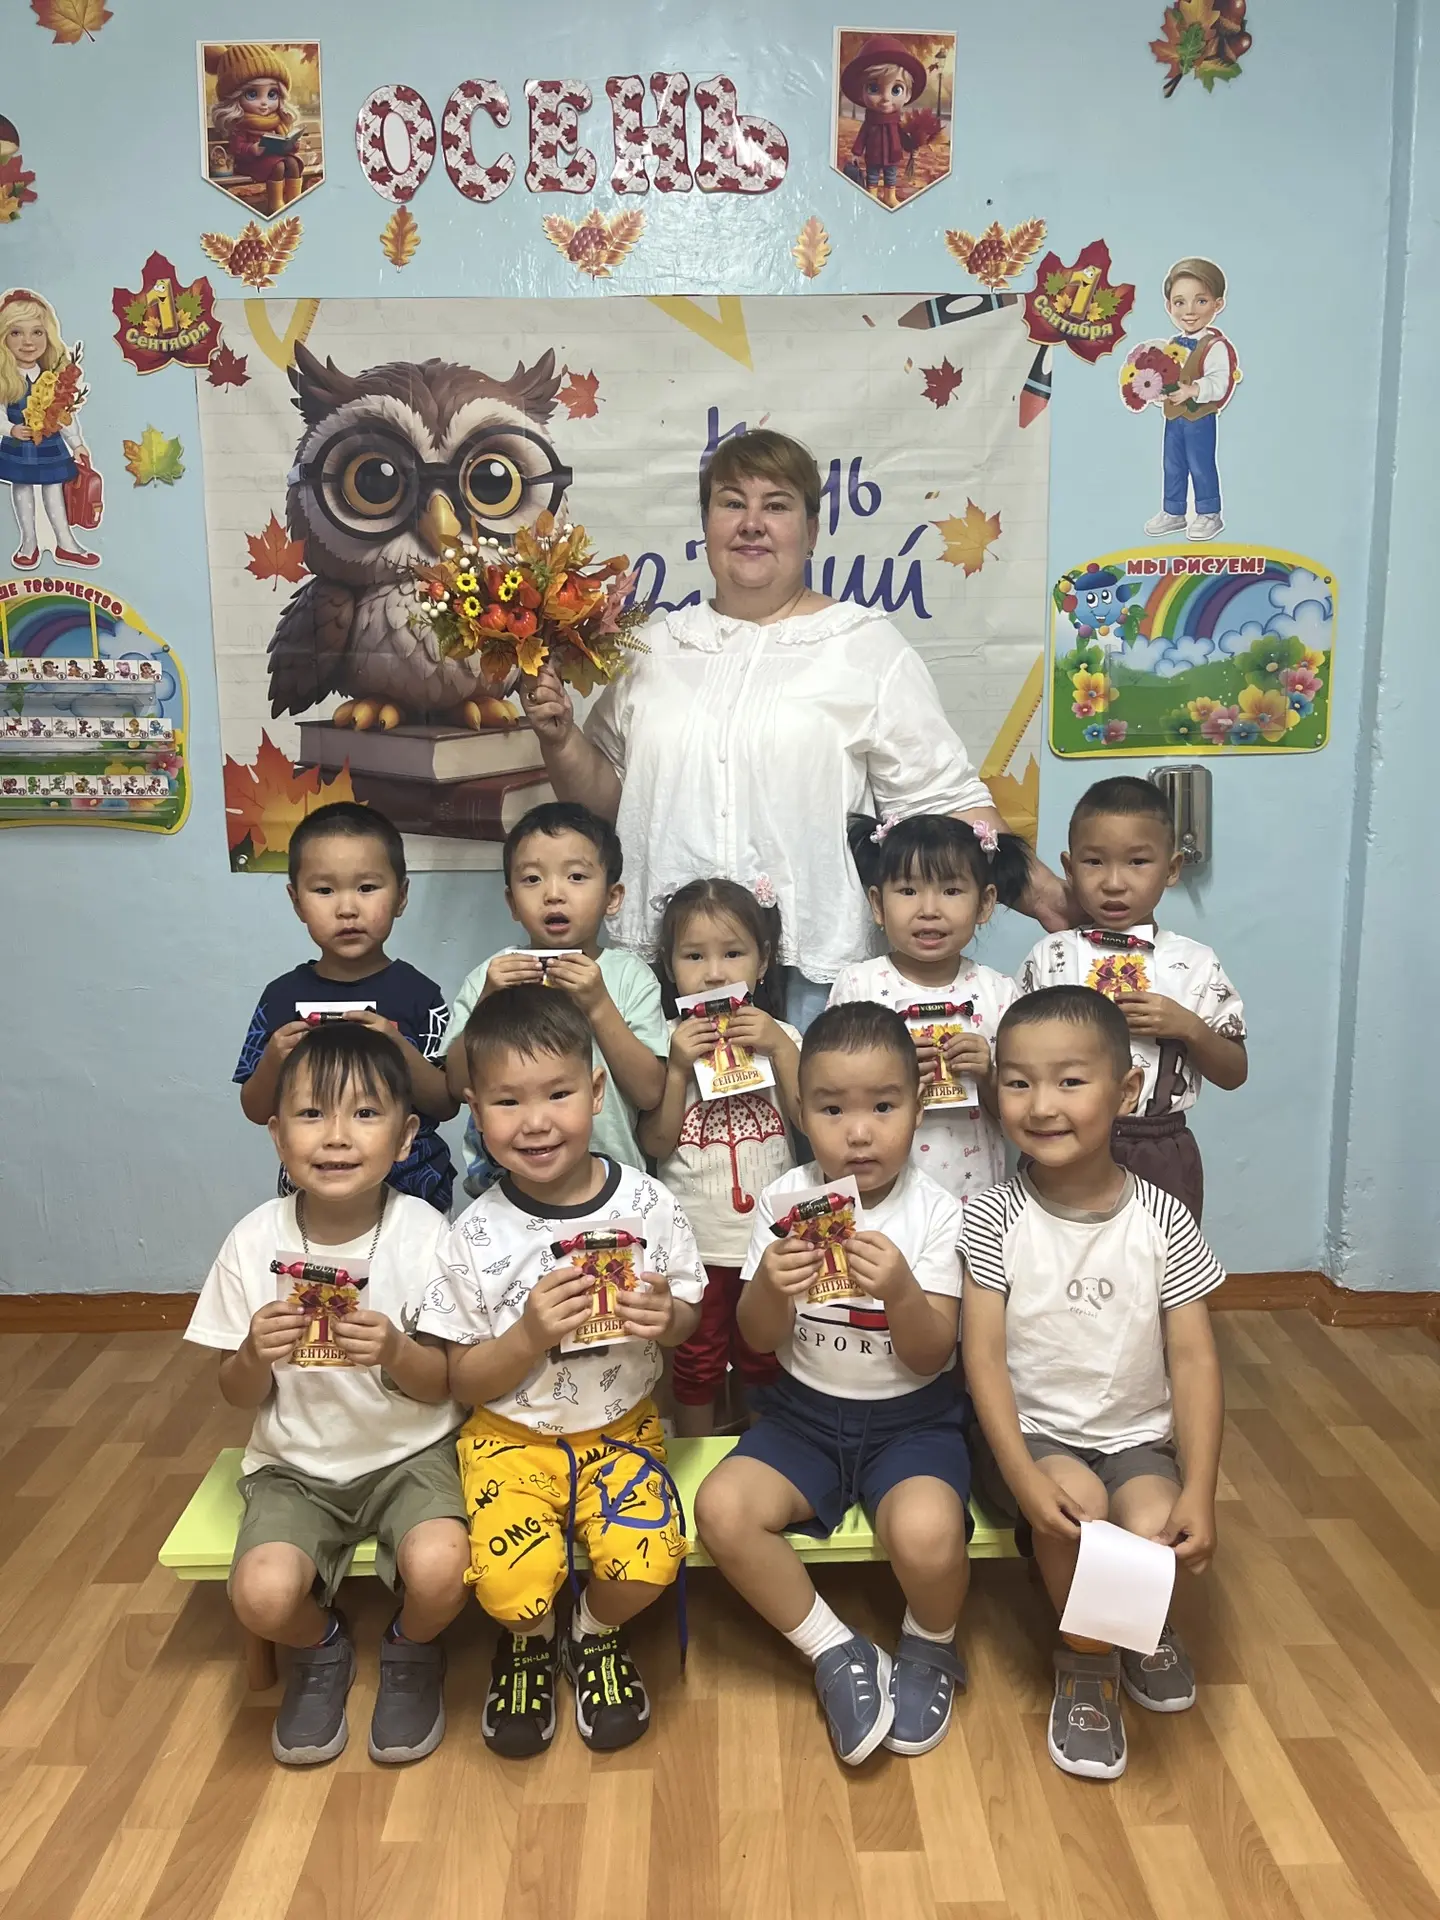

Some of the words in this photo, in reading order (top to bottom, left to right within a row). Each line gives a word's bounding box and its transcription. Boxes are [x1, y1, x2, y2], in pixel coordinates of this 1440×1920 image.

[355, 72, 789, 204] ОСЕНЬ
[146, 278, 179, 334] 1
[1068, 265, 1102, 321] 1
[1034, 294, 1114, 341] Сентября
[125, 320, 212, 352] Сентября
[1127, 558, 1167, 575] МЫ
[1172, 557, 1265, 575] РИСУЕМ!
[23, 577, 123, 616] ТВОРЧЕСТВО
[712, 1070, 760, 1087] СЕНТЯБРЯ
[925, 1086, 963, 1097] НТЯБРЯ
[576, 1320, 625, 1336] СЕНТЯБР
[798, 1327, 894, 1355] SPORT
[489, 1517, 542, 1556] OMG
[522, 1652, 550, 1664] SH-LAB
[584, 1643, 611, 1655] SH-LAB
